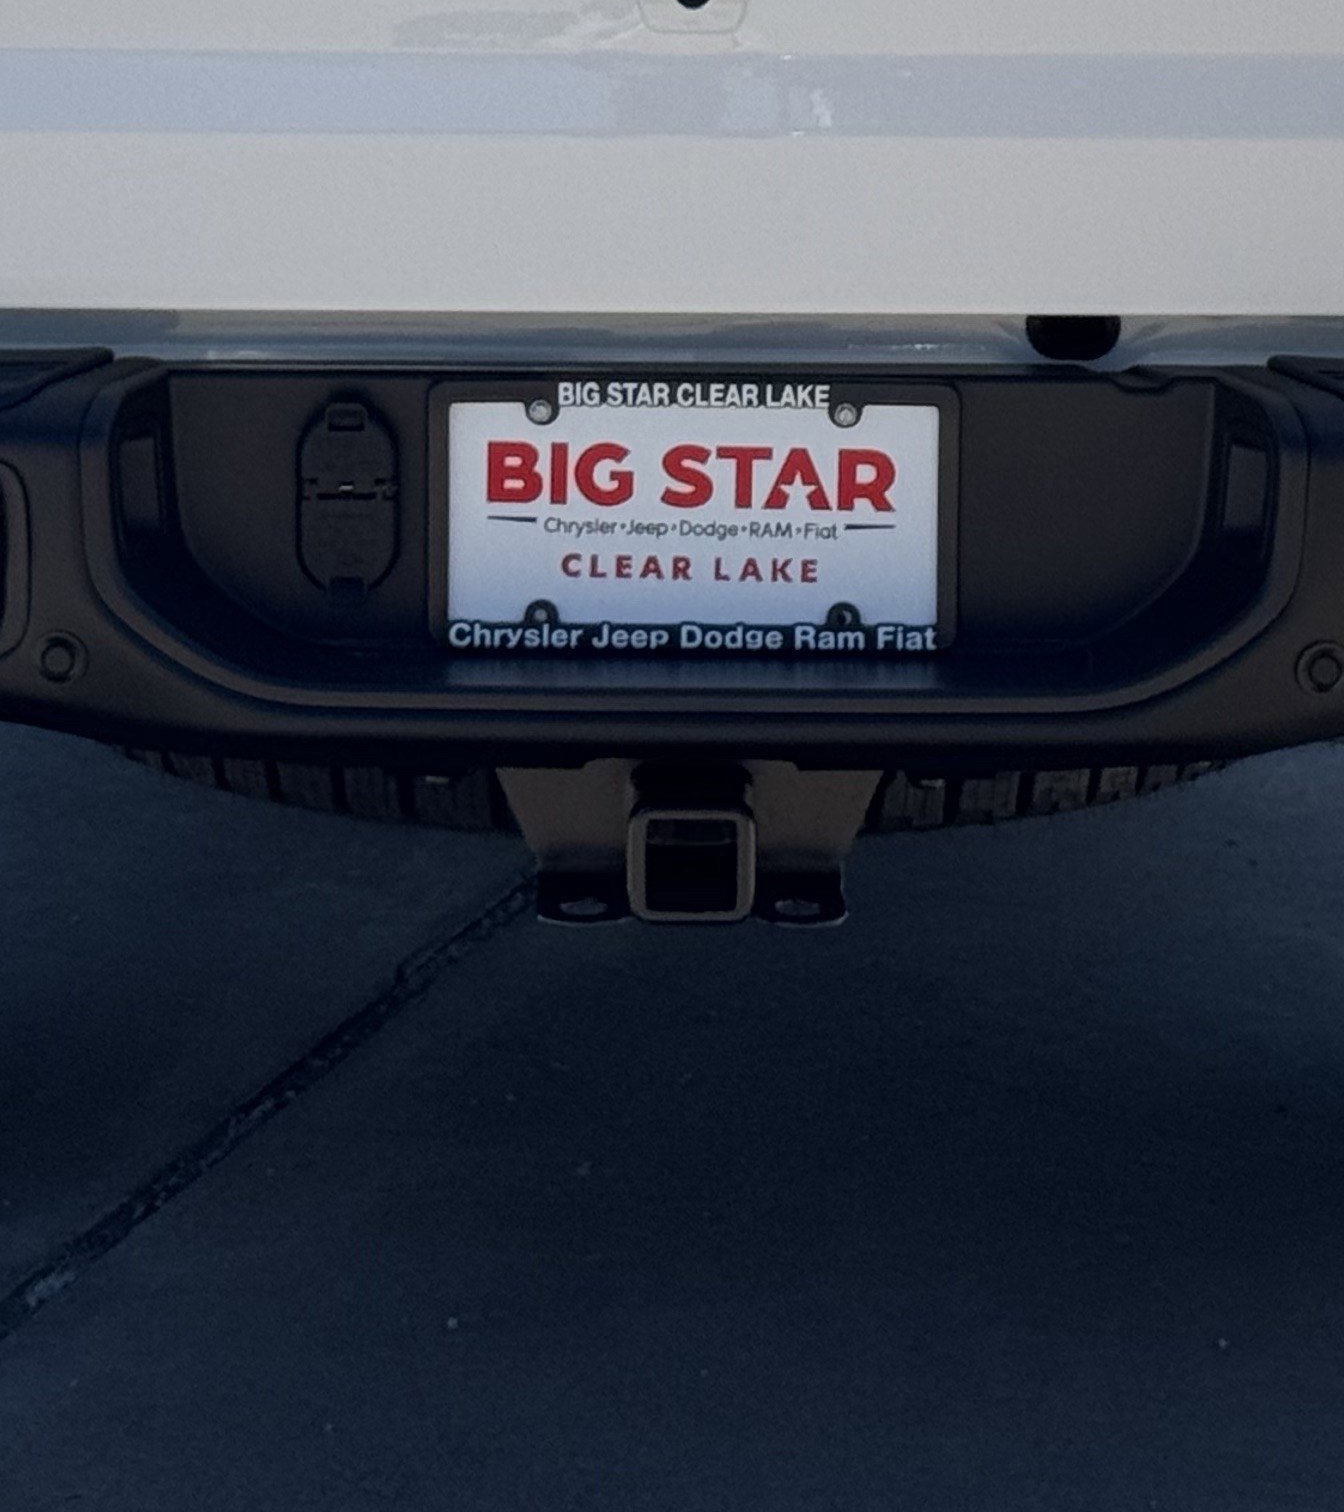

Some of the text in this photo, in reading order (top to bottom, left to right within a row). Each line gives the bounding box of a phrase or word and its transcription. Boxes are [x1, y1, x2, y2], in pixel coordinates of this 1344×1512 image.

[558, 382, 830, 408] BIG STAR CLEAR LAKE
[486, 441, 896, 512] BIG STAR
[561, 553, 818, 583] CLEAR LAKE
[449, 622, 937, 651] Chrysler Jeep Dodge Ram Fiat
